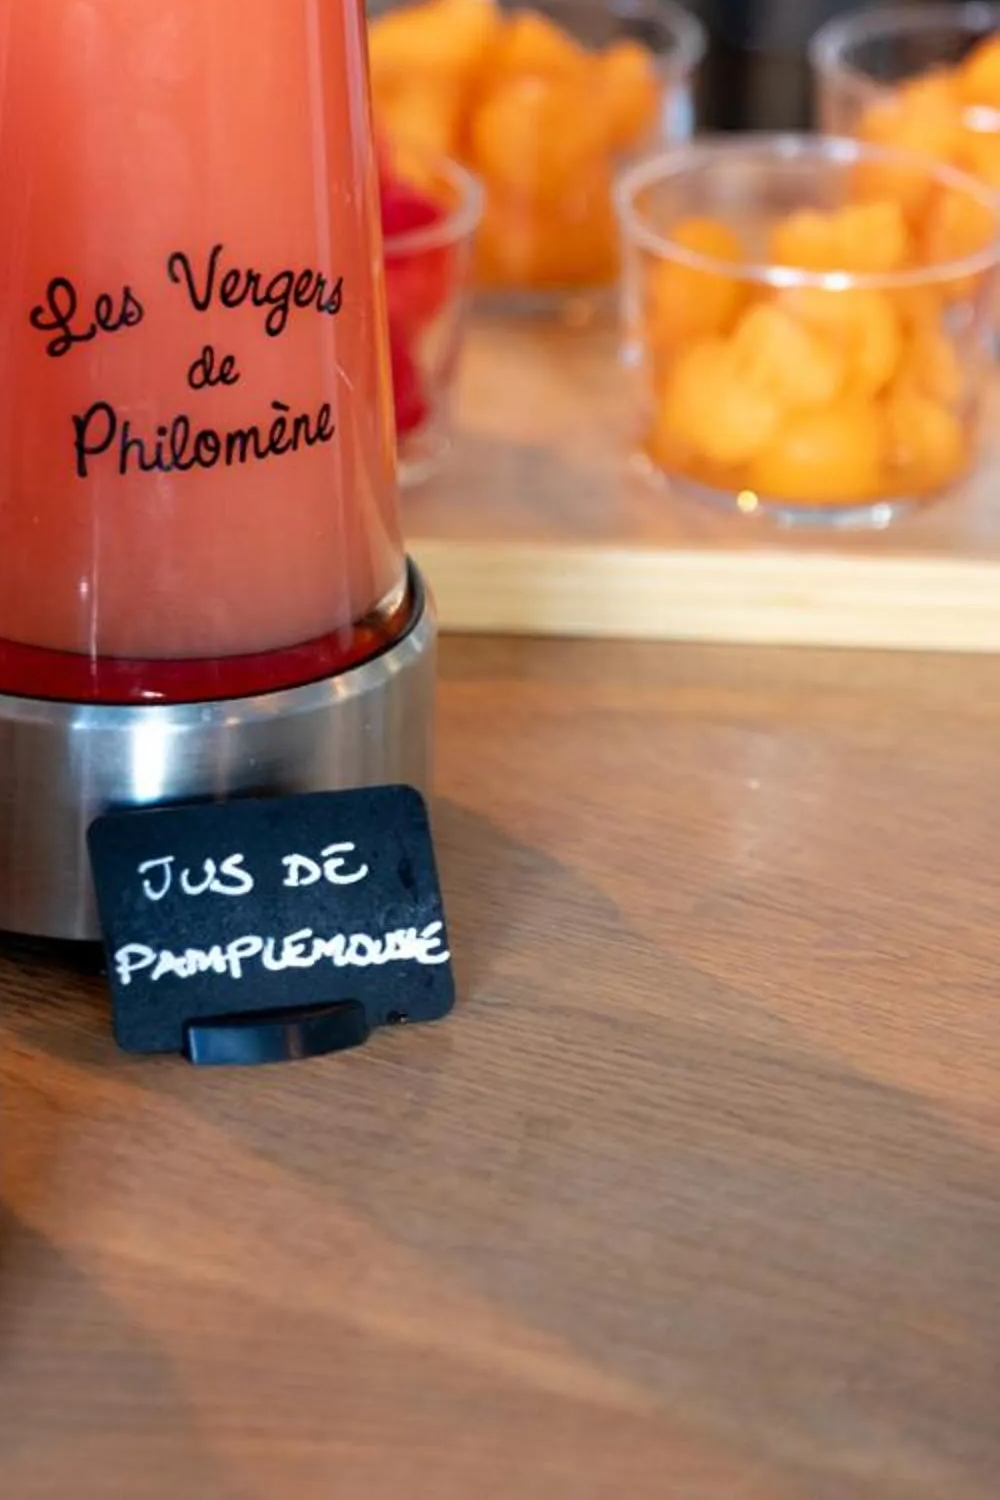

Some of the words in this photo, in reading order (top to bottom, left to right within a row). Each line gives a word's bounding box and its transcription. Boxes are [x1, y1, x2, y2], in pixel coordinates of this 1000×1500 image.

[30, 277, 144, 357] Les
[167, 243, 344, 337] Vergers
[187, 345, 240, 390] de
[72, 401, 335, 478] Philomène
[138, 853, 254, 900] JUS
[282, 842, 368, 887] DE
